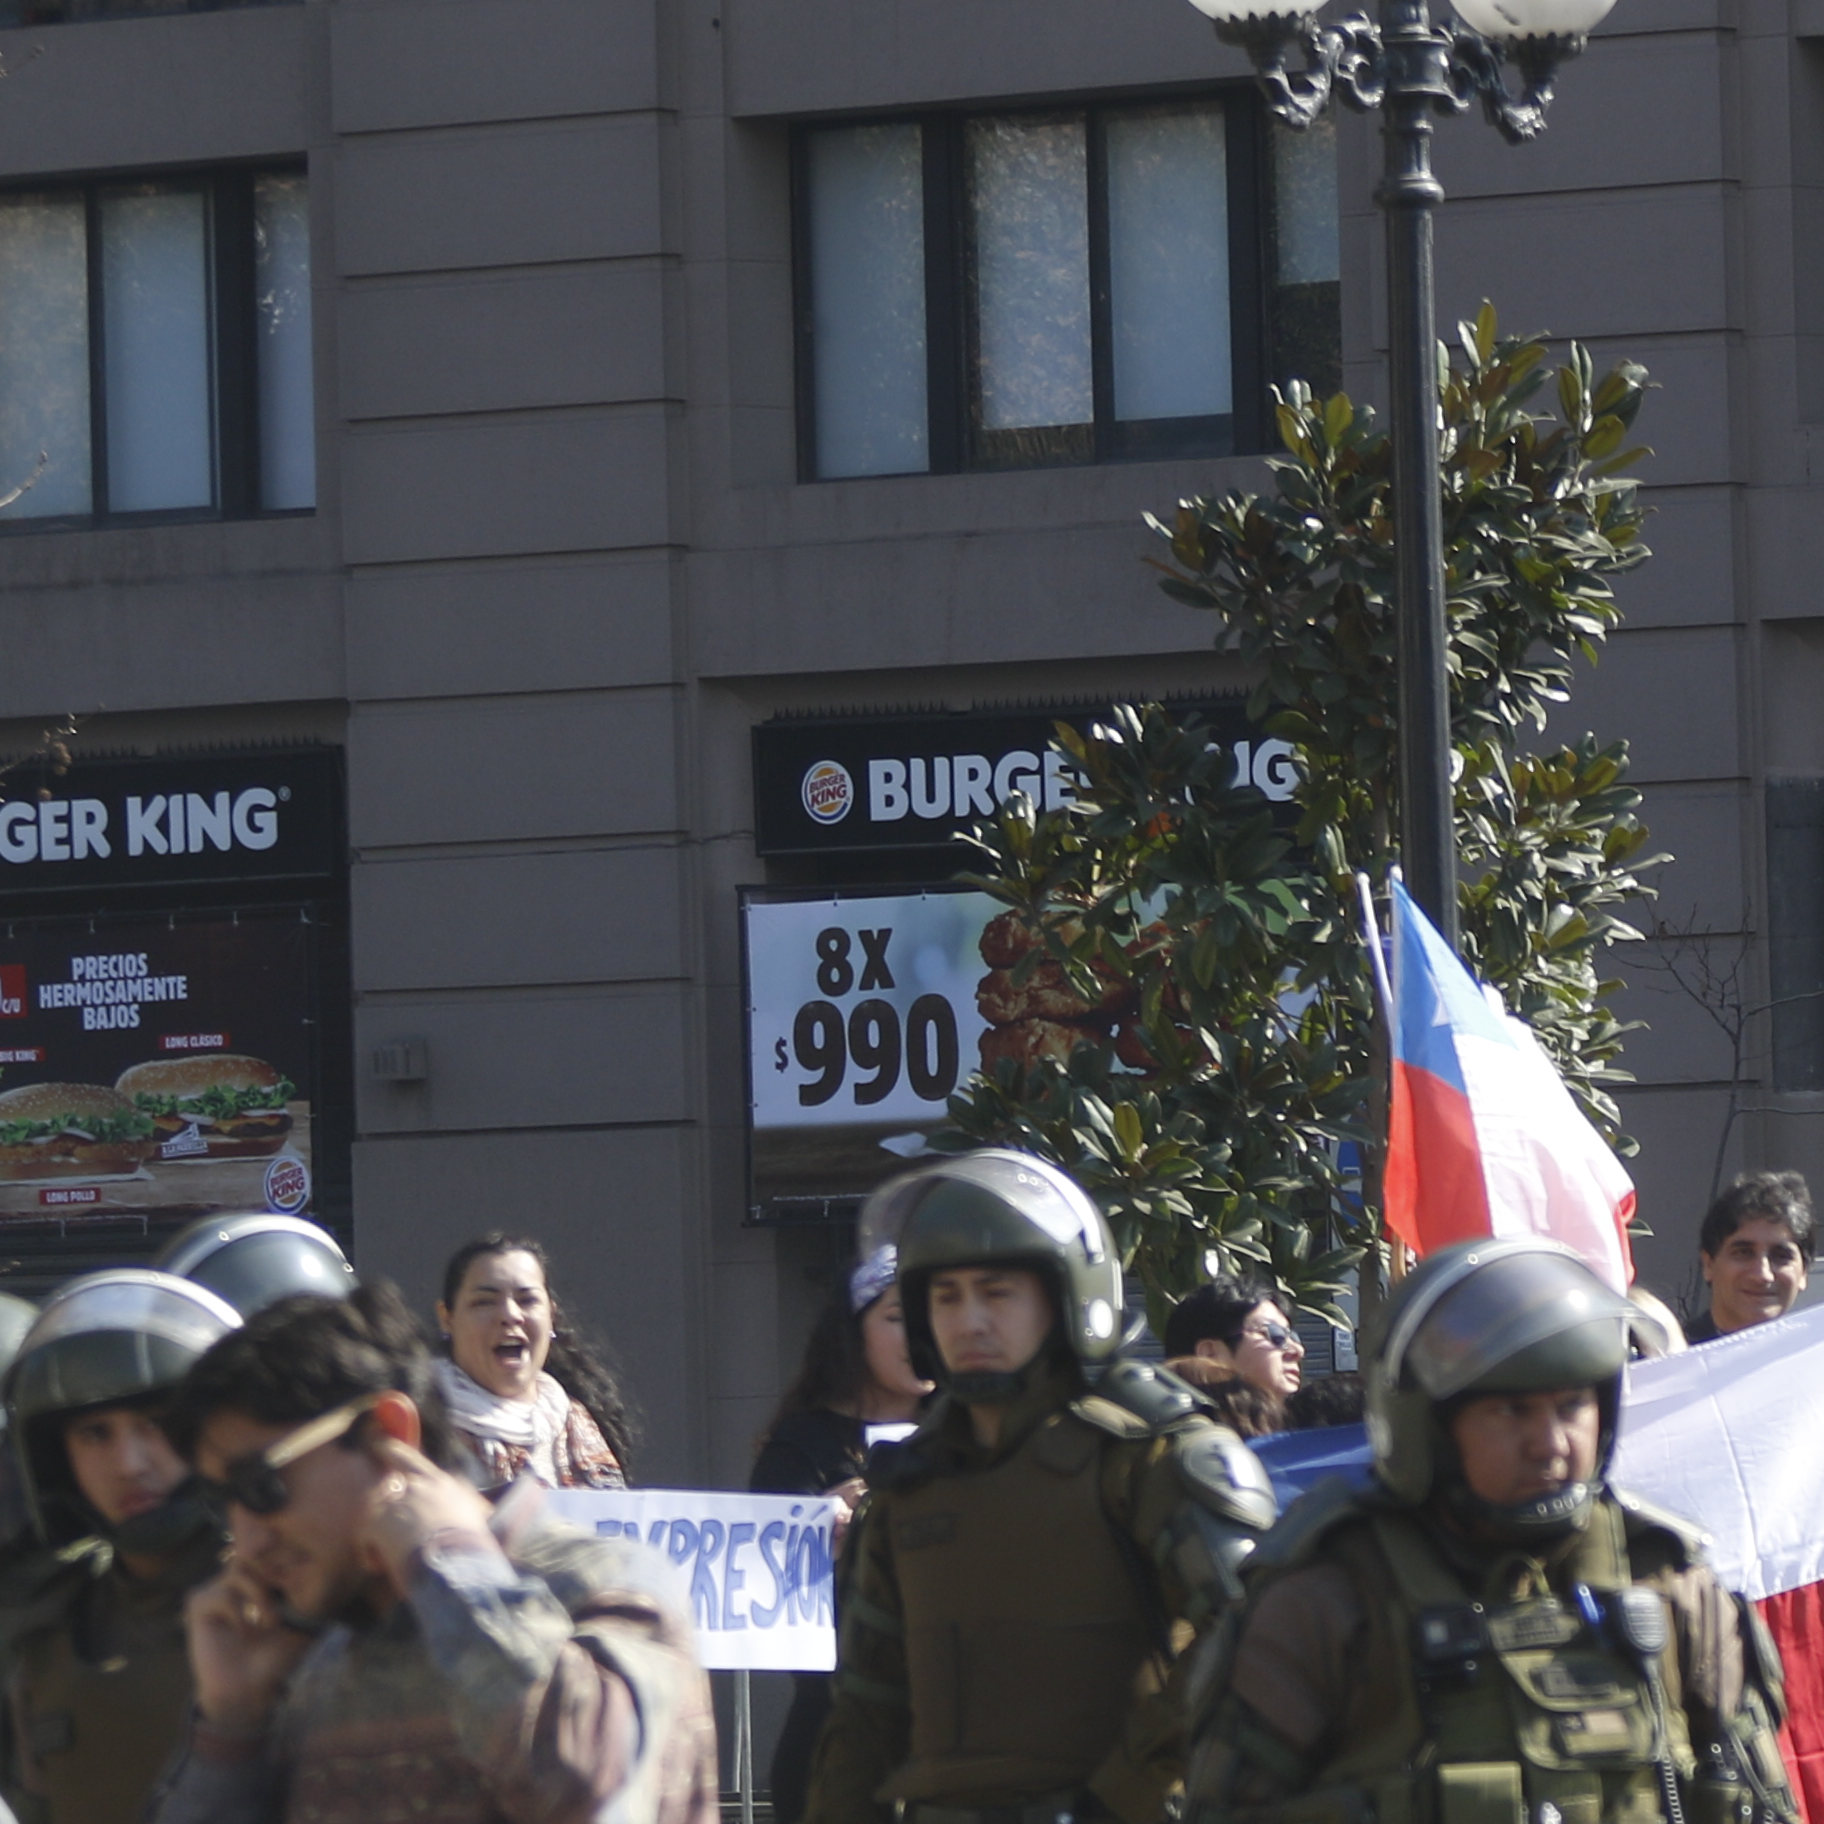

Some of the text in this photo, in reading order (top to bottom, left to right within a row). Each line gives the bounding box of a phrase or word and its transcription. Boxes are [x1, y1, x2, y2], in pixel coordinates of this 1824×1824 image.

[809, 773, 846, 793] BURGER
[811, 784, 848, 807] KING
[868, 749, 1093, 822] BURGE
[126, 787, 278, 857] KING
[72, 953, 149, 981] PRECIOS
[816, 926, 896, 997] 8X
[39, 975, 188, 1009] HERMOSAMENTE
[83, 1004, 141, 1031] BAJOS
[270, 1167, 304, 1189] BURGER
[272, 1178, 306, 1200] KING
